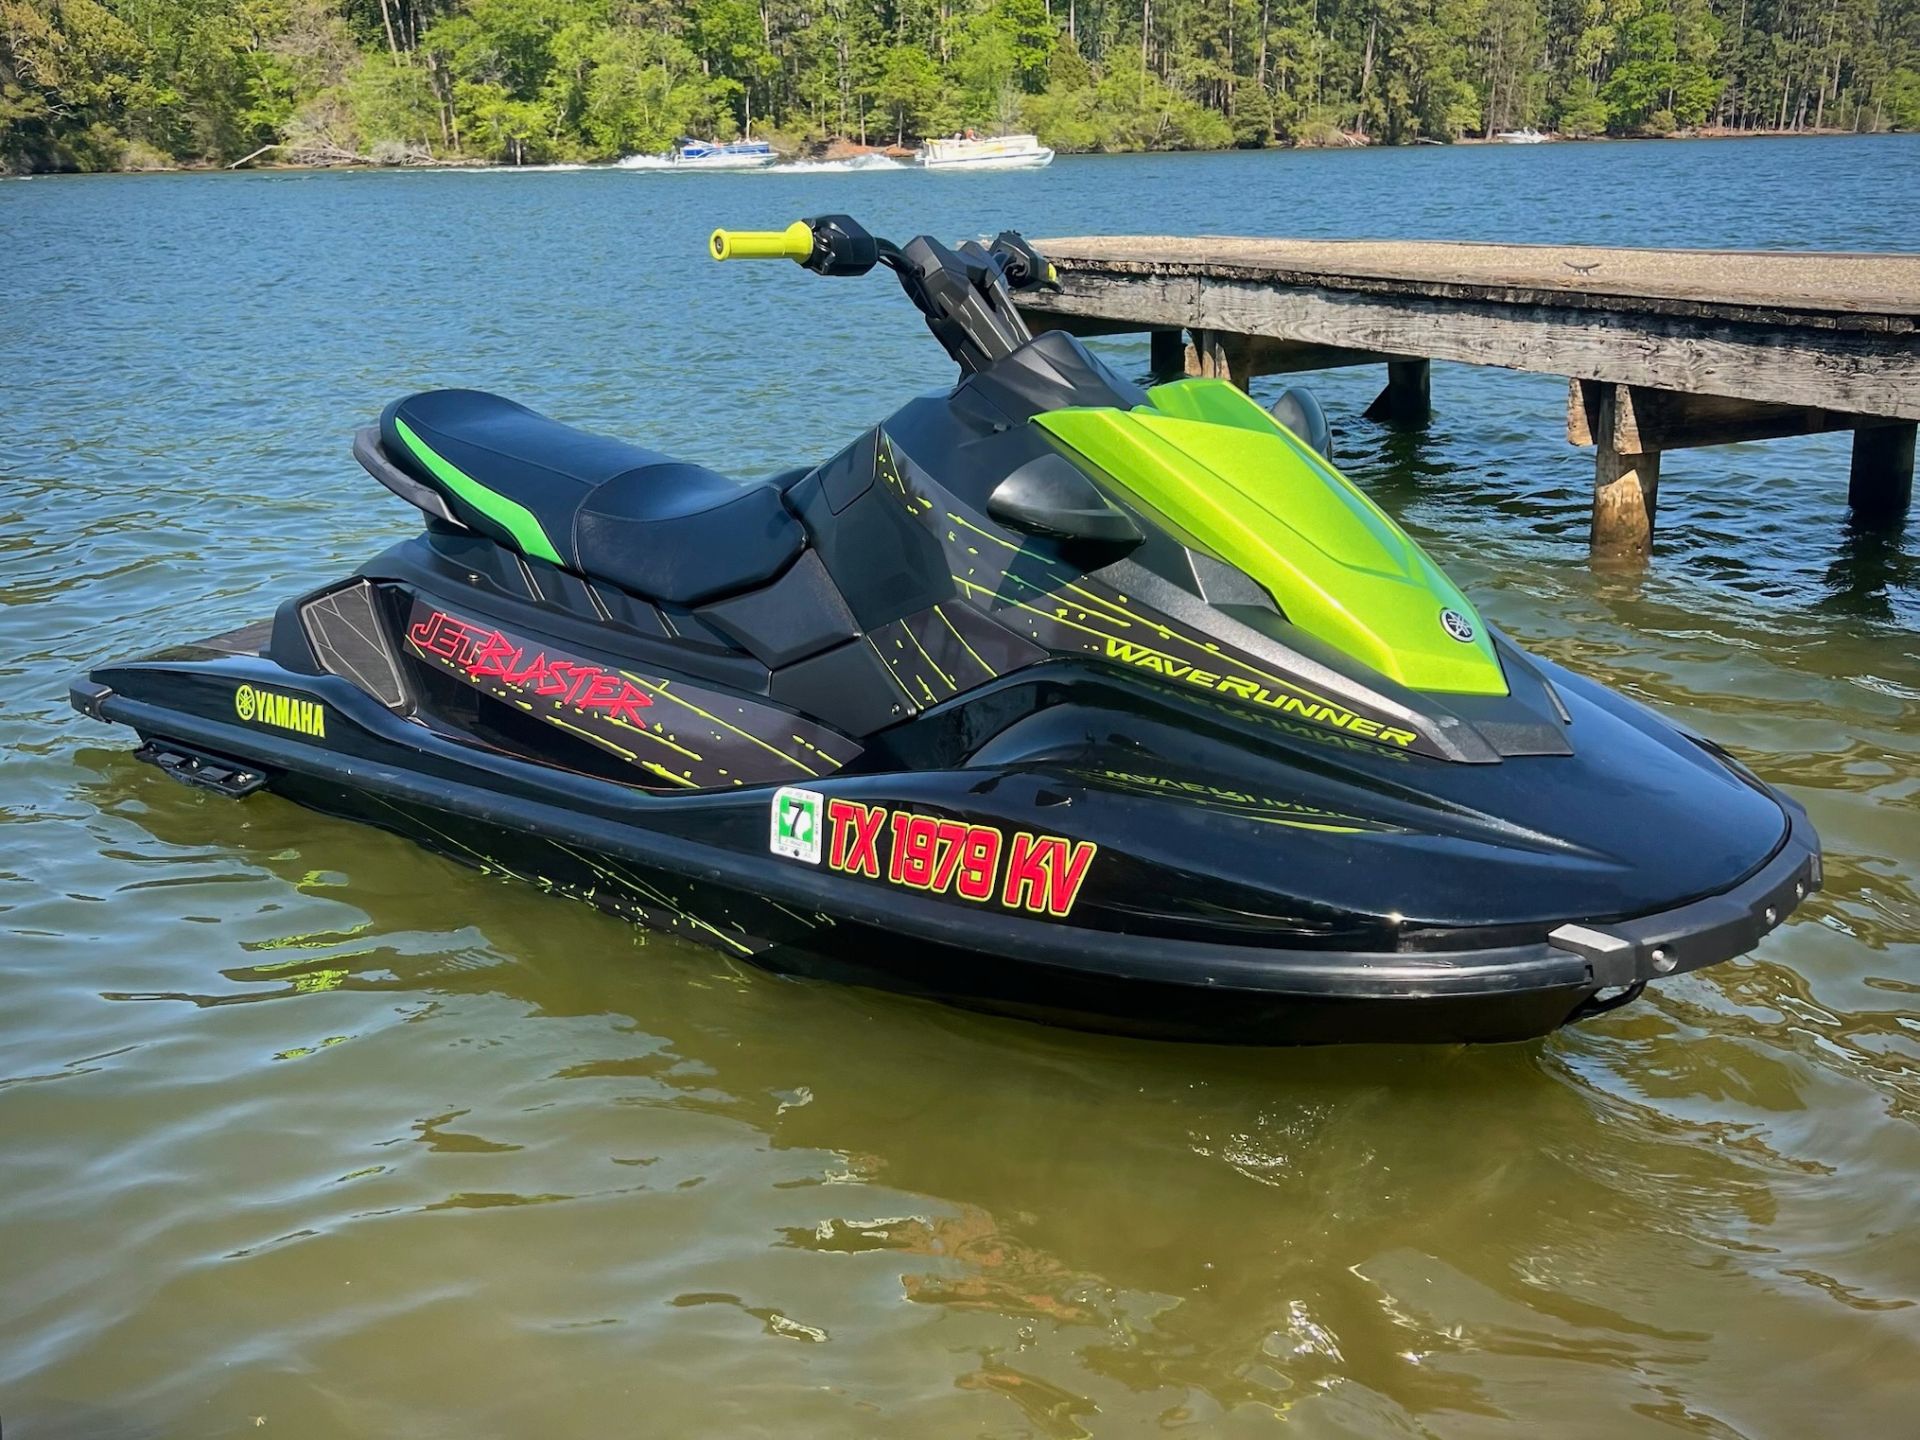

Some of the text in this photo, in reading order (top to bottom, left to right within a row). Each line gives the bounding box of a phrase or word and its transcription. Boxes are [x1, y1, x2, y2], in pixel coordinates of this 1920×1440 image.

[254, 690, 326, 738] YAMAHA
[1105, 639, 1417, 747] WAVERUNNER
[789, 800, 805, 837] 7
[828, 798, 886, 879] TX
[889, 811, 1001, 902] 1979
[1002, 832, 1097, 917] KV
